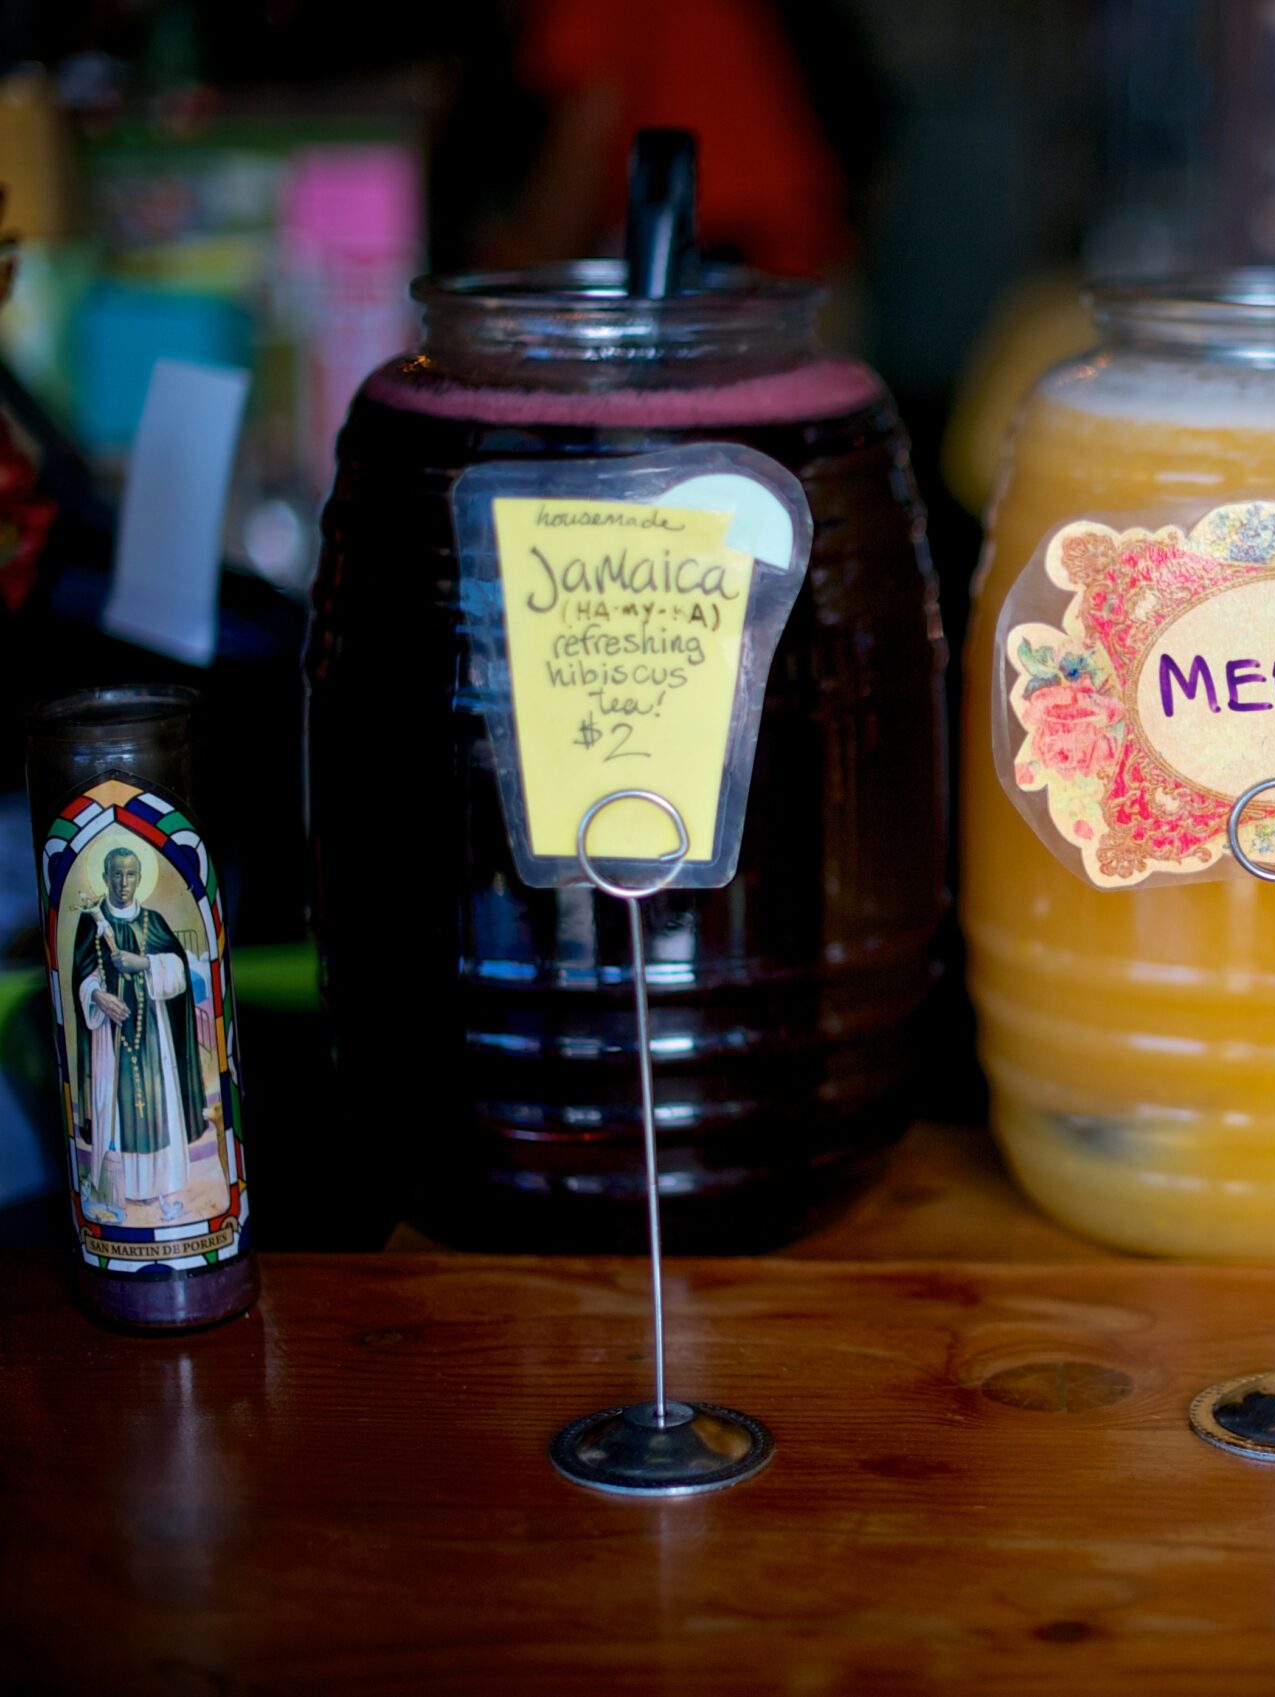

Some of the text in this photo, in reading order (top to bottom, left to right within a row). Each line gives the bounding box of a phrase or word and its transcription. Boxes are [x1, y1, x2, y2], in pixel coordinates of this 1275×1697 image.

[553, 622, 706, 665] refreshing
[546, 660, 688, 689] hibiscus
[588, 687, 666, 718] tea!
[572, 711, 652, 763] $2
[90, 1233, 228, 1257] SAN MARTIN DE PORRES
